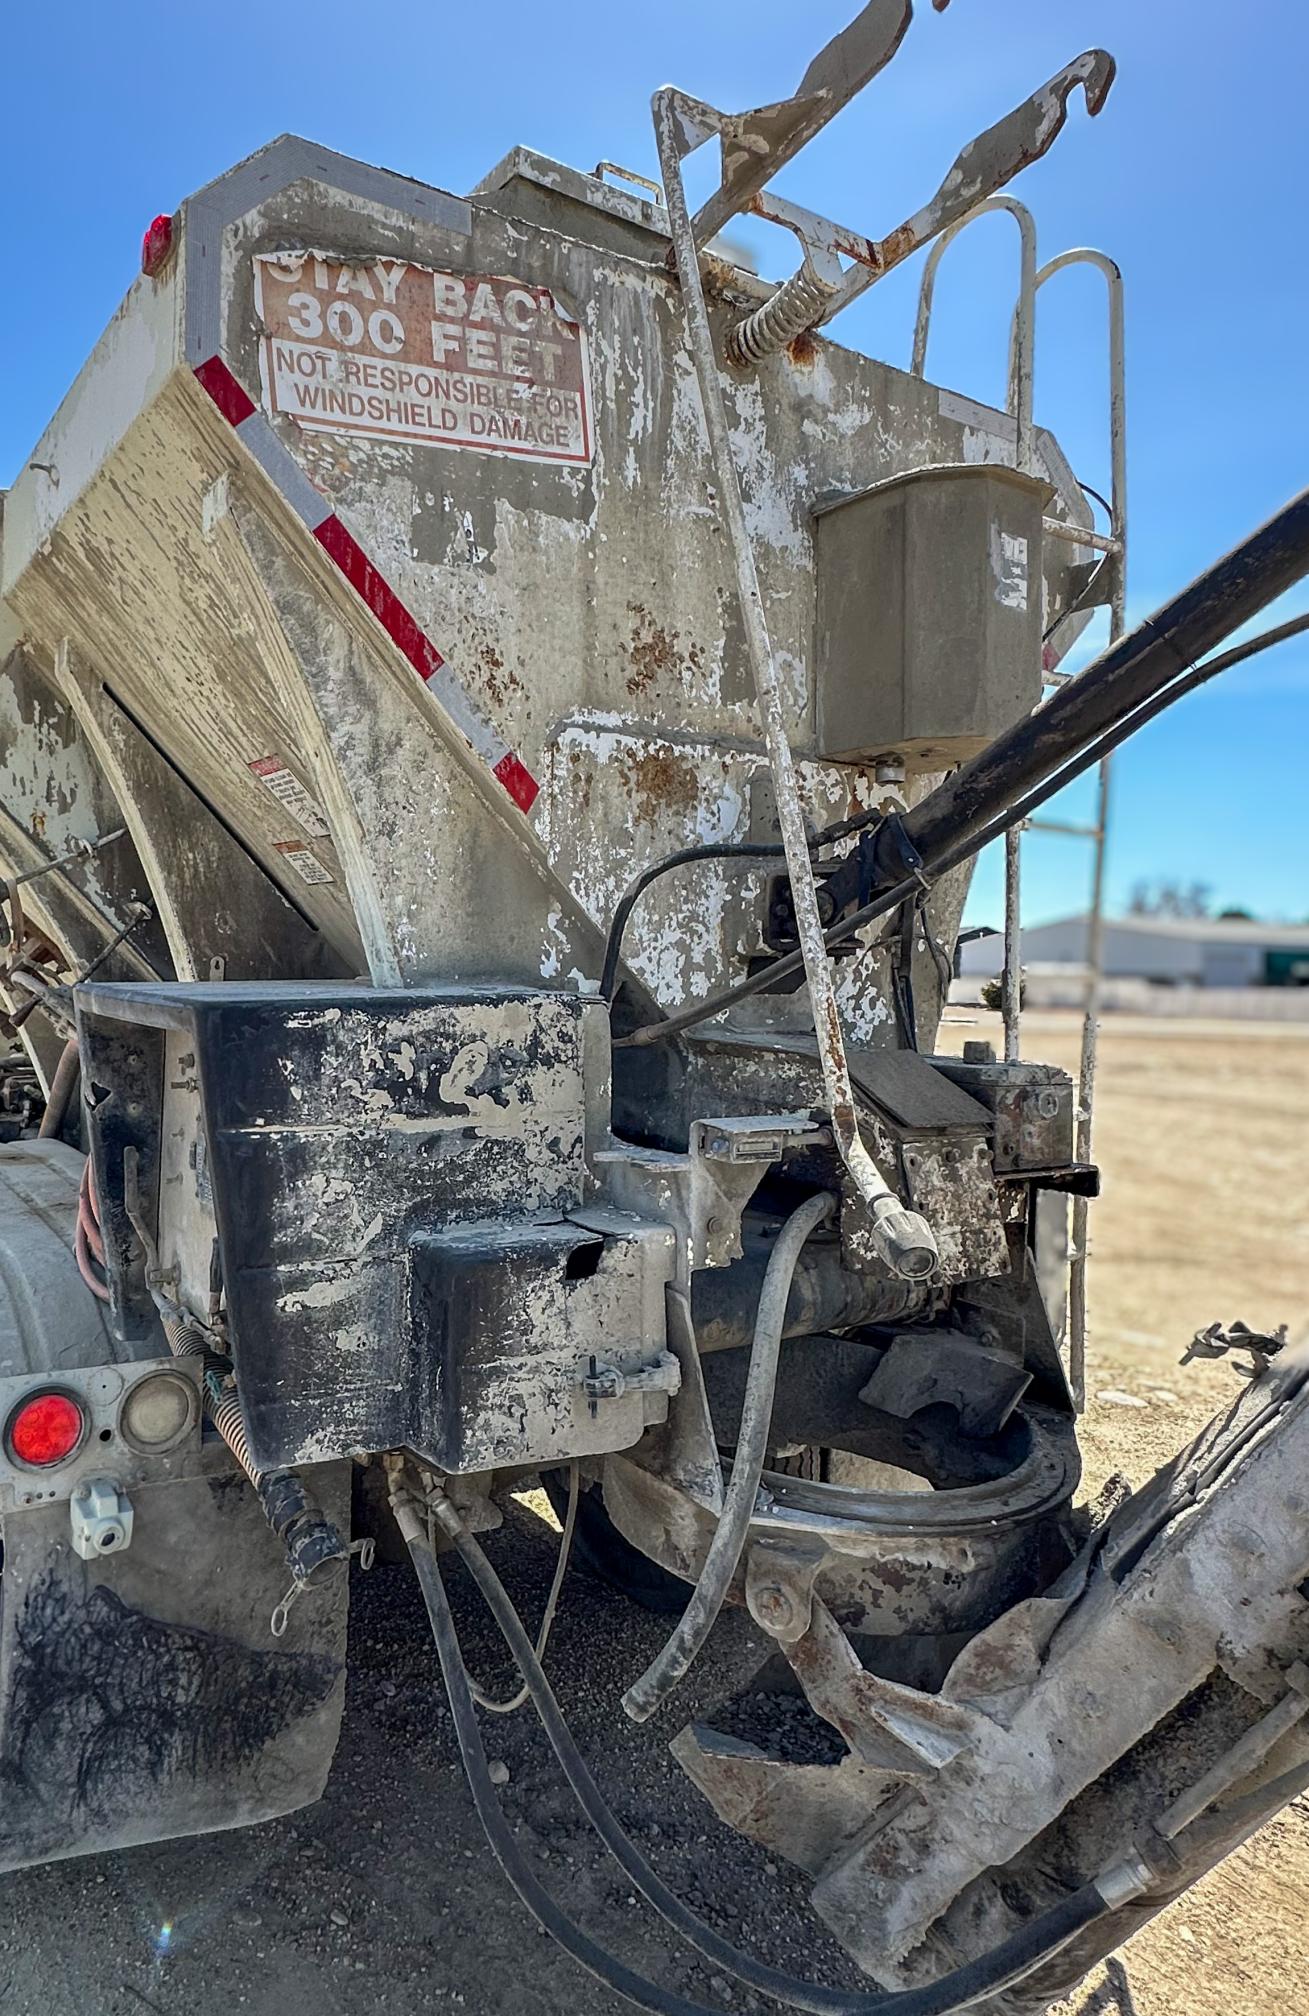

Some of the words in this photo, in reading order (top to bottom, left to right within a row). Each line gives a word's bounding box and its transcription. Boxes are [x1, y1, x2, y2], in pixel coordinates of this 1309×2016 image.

[288, 292, 405, 354] 300
[431, 320, 562, 382] FEET
[433, 272, 576, 340] BACK
[276, 346, 332, 380] NOT
[343, 359, 522, 411] RESPONSIBLE
[529, 391, 578, 421] FOR
[294, 382, 458, 431] WINDSHIELD
[469, 412, 570, 448] DAMAGE
